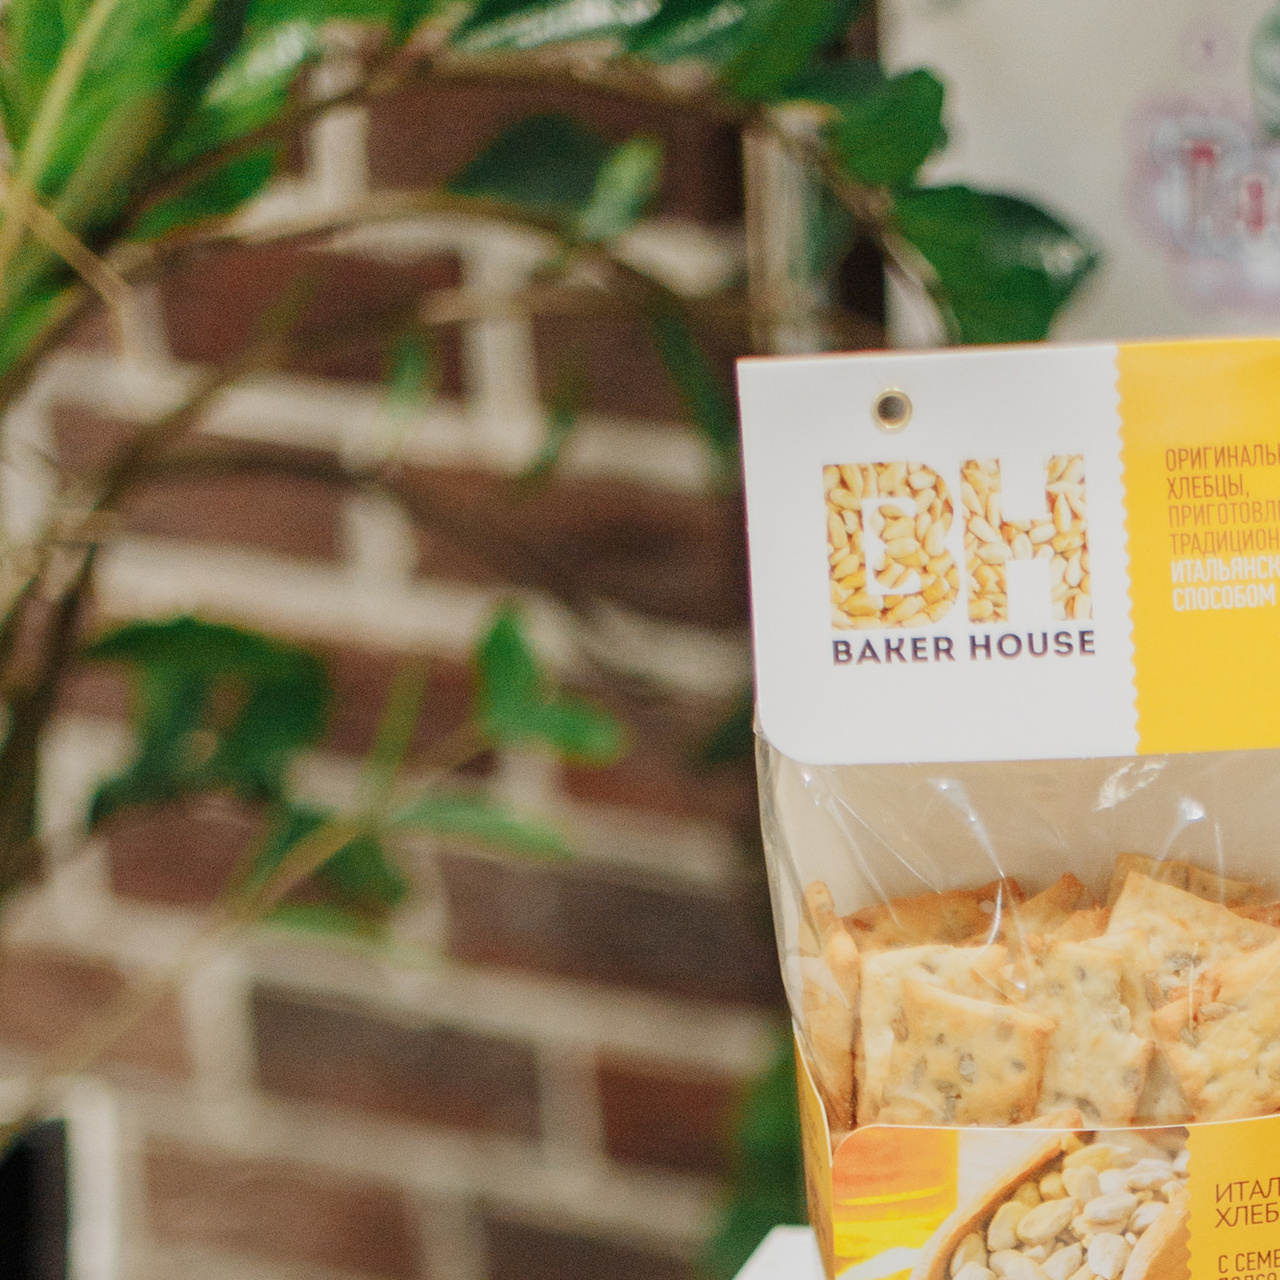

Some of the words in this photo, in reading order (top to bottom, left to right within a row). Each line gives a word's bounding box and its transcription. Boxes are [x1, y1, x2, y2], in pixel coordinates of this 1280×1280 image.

[1166, 473, 1250, 501] ХЛЕБЦЫ,
[822, 454, 1094, 632] BH
[1172, 582, 1277, 612] СПОСОБОМ
[832, 636, 956, 666] BAKER
[968, 629, 1096, 661] HOUSE
[1218, 1254, 1229, 1274] С
